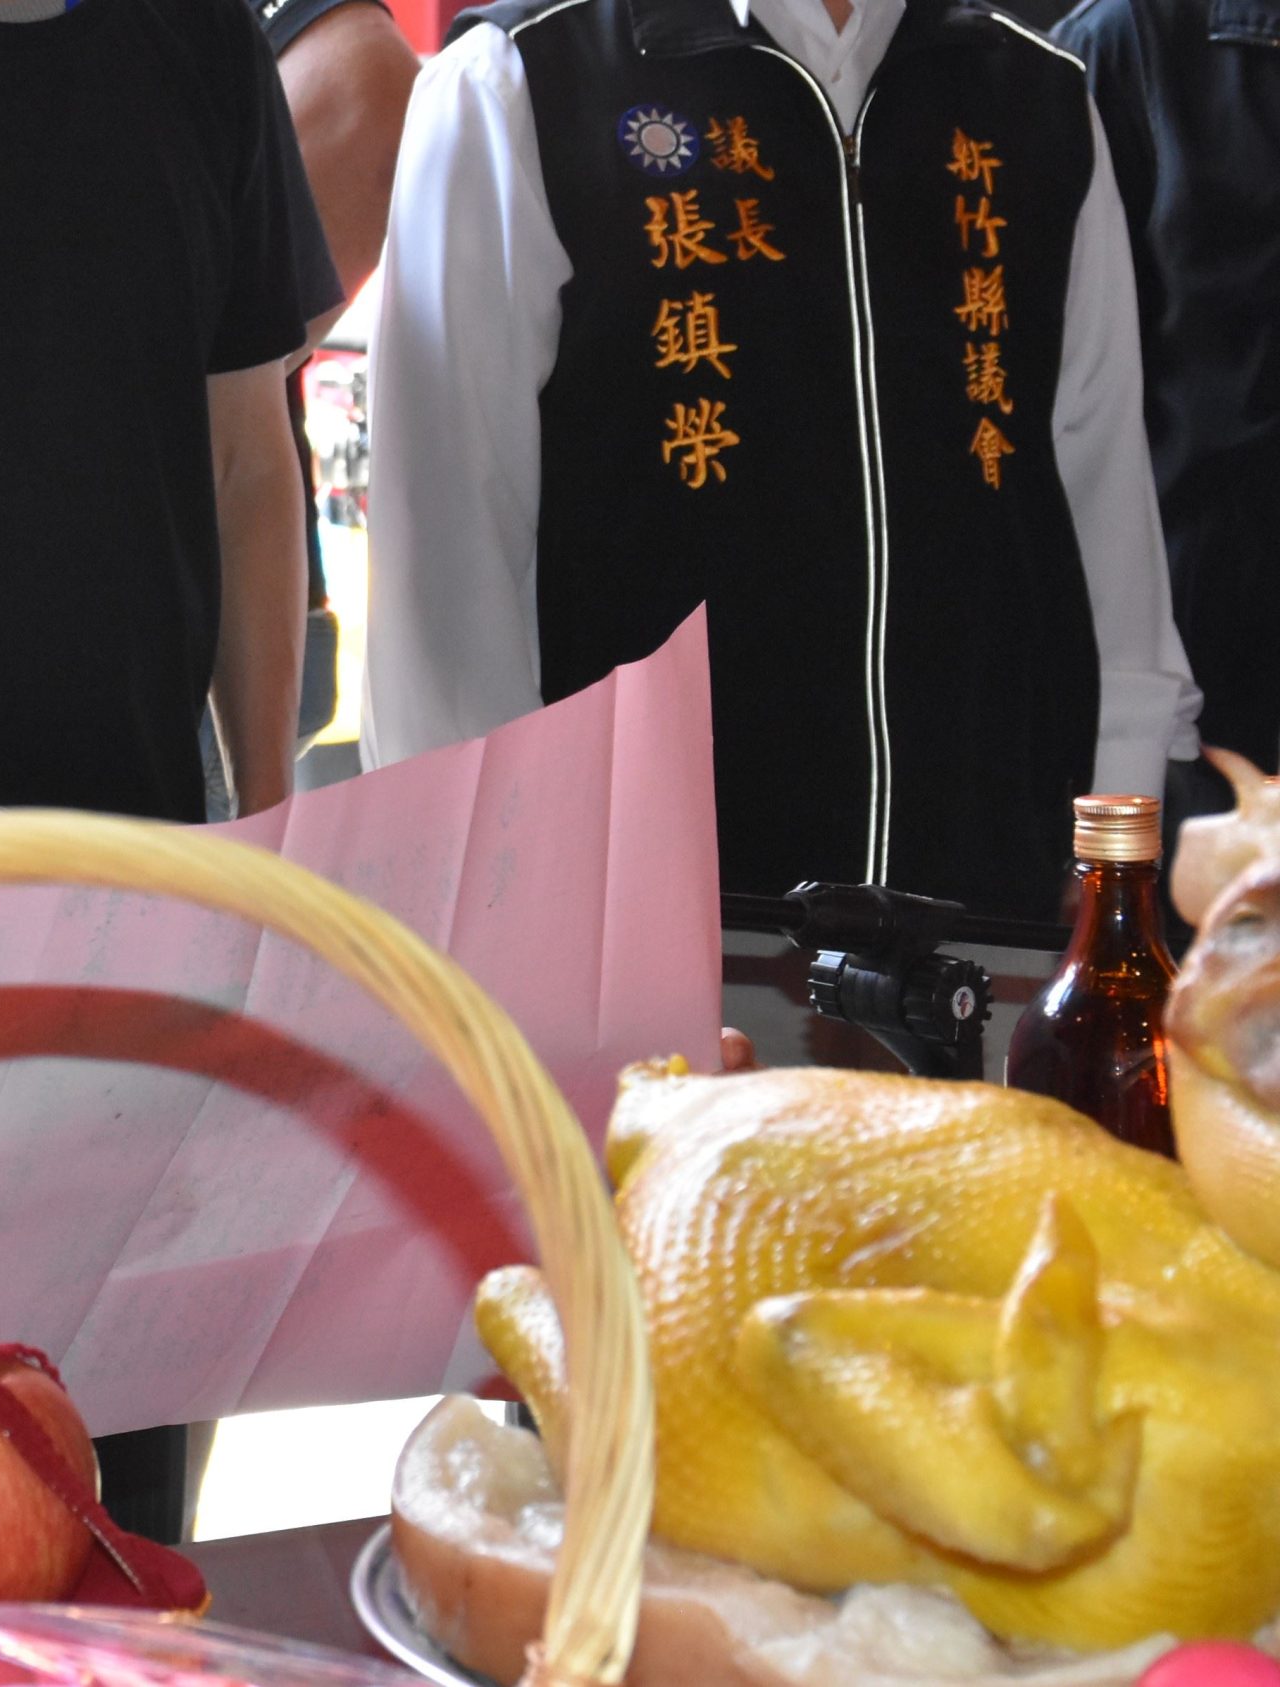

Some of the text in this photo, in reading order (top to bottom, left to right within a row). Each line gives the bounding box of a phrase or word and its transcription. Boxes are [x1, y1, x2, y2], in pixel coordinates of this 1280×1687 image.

[706, 116, 785, 261] 議長
[947, 130, 1014, 488] 新竹縣議會
[643, 189, 741, 489] 張鎮榮
